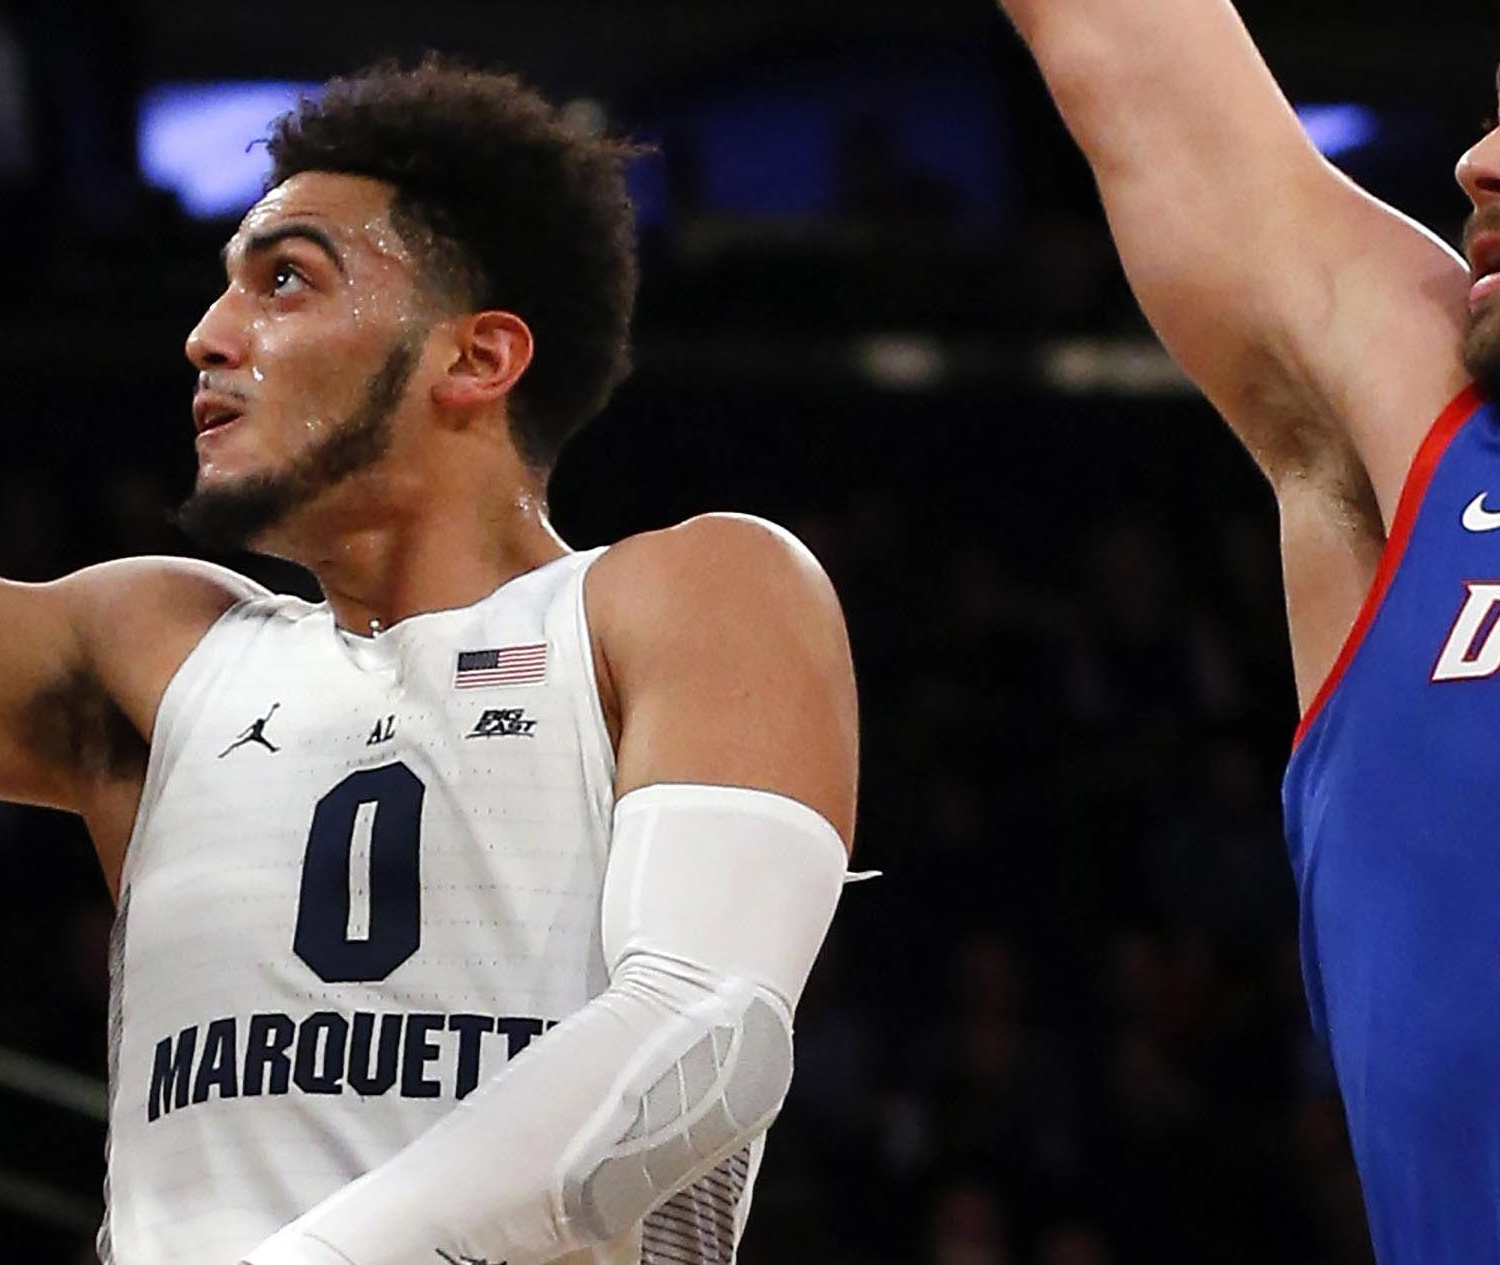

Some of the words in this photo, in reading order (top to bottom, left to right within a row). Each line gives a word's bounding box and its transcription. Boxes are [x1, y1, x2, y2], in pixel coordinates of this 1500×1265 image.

[366, 714, 396, 746] AL
[292, 761, 426, 984] 0
[148, 1012, 561, 1123] MARQUETT
